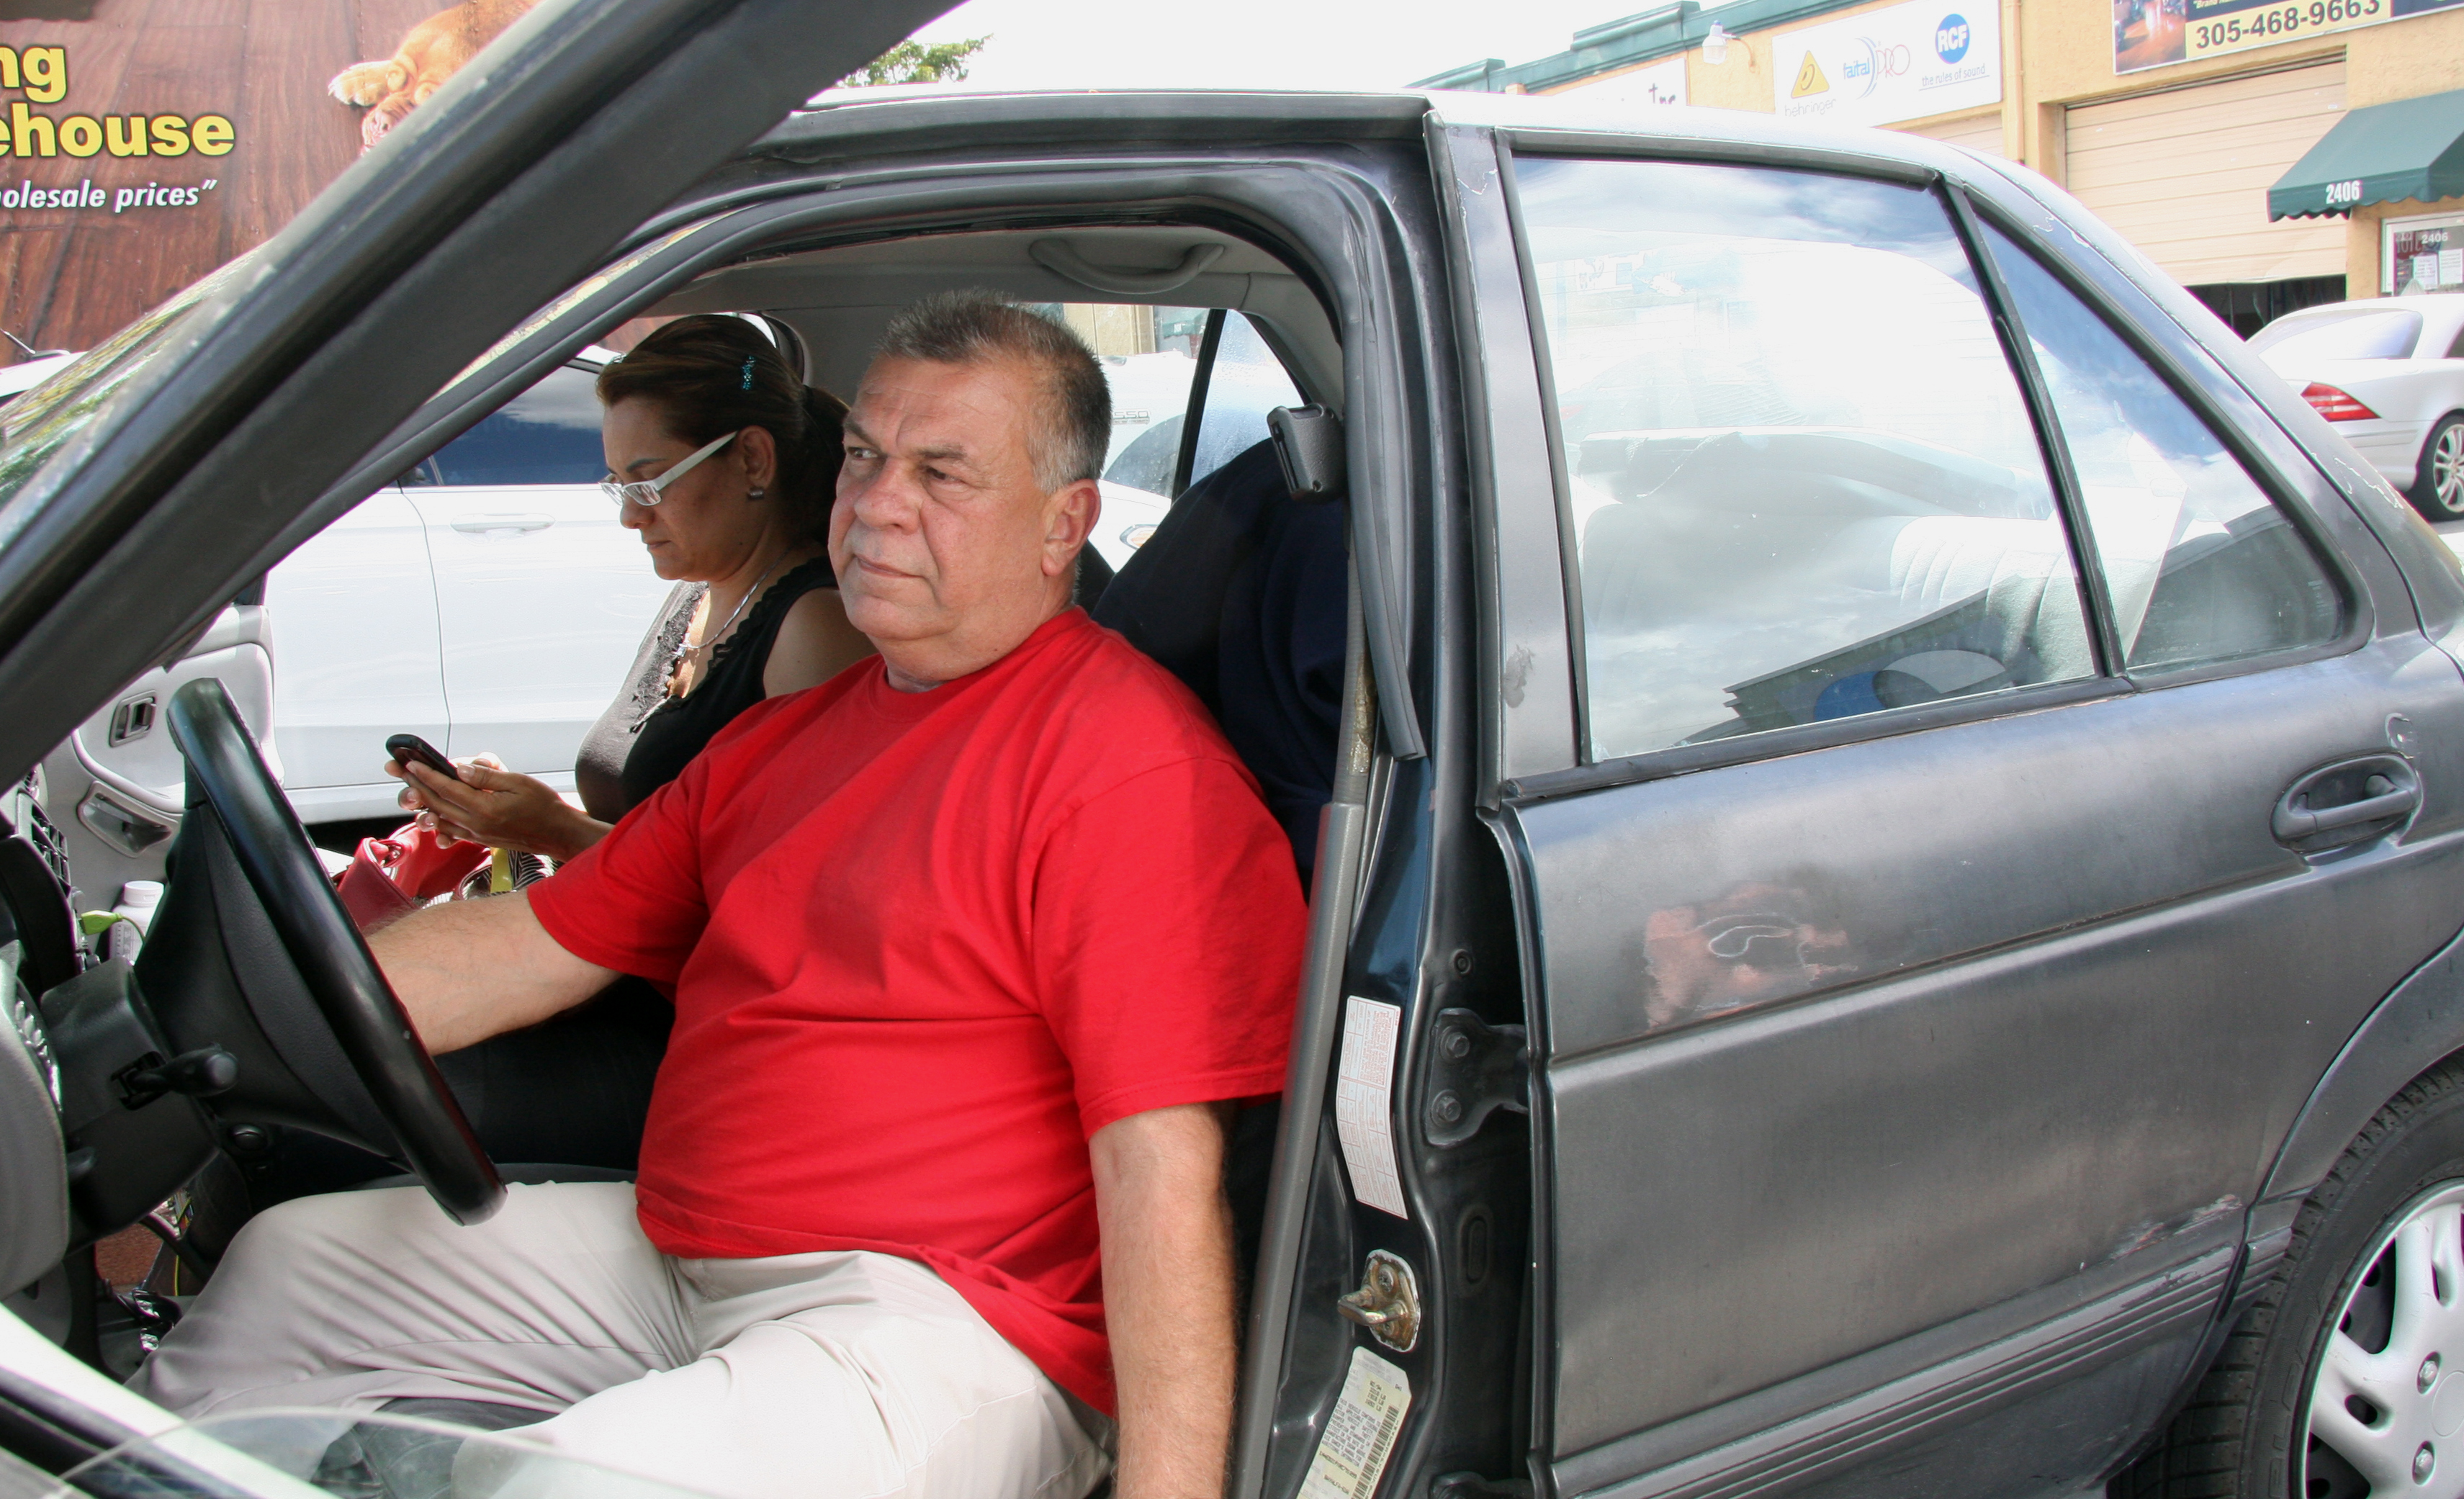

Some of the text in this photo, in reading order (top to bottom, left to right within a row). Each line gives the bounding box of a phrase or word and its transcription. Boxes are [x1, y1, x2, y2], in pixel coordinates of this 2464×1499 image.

[2196, 0, 2380, 49] 305-468-9663
[1938, 24, 1968, 53] RCF
[1922, 63, 1986, 87] the rules of sound
[1784, 98, 1837, 117] behringer
[0, 102, 235, 157] house
[0, 179, 107, 208] olesale
[2325, 180, 2362, 204] 2406
[2421, 231, 2450, 245] 2406
